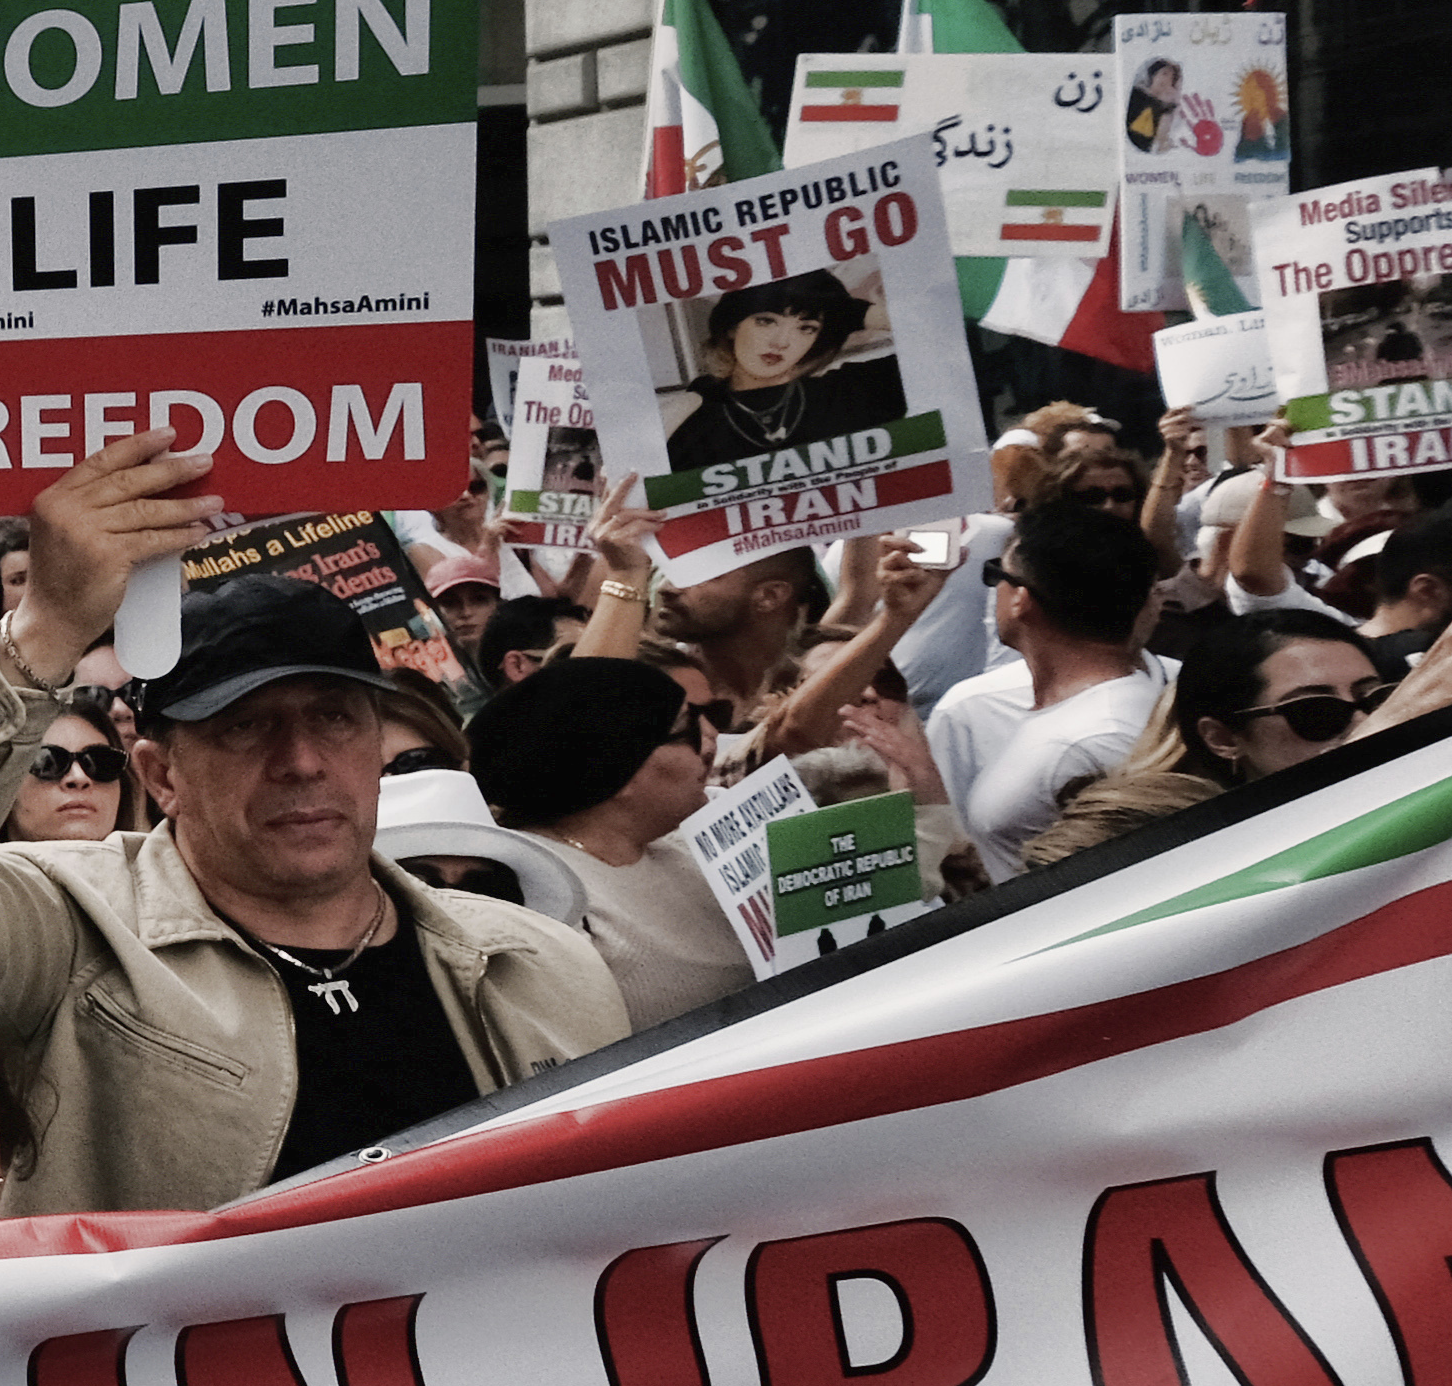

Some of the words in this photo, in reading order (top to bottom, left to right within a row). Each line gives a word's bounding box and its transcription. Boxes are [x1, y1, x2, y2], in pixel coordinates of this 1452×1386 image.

[1054, 71, 1103, 112] زن
[589, 207, 723, 255] ISLAMIC
[735, 160, 901, 226] REPUBLIC
[1299, 191, 1381, 226] Media
[11, 179, 289, 291] LIFE
[594, 223, 791, 310] MUST
[824, 191, 919, 261] GO
[1273, 261, 1333, 297] The
[261, 293, 430, 318] #MahsaAmini
[492, 341, 558, 357] IRANIAN
[525, 401, 560, 424] The
[701, 427, 892, 496] STAND
[777, 480, 807, 497] with
[809, 476, 830, 491] the
[832, 467, 881, 489] People
[884, 461, 900, 476] of
[539, 493, 600, 514] STA
[725, 478, 878, 536] IRAN
[183, 547, 261, 581] Mullahs
[265, 538, 284, 556] a
[284, 510, 374, 548] Lifeline
[732, 517, 862, 556] #MahsaAmini
[323, 565, 398, 600] dents
[694, 830, 718, 863] NO
[709, 810, 747, 853] MORE
[830, 834, 856, 854] THE
[777, 860, 854, 895] DEMOCRATIC
[857, 846, 914, 874] REPUBLIC
[825, 888, 841, 907] OF
[843, 882, 872, 904] IRAN
